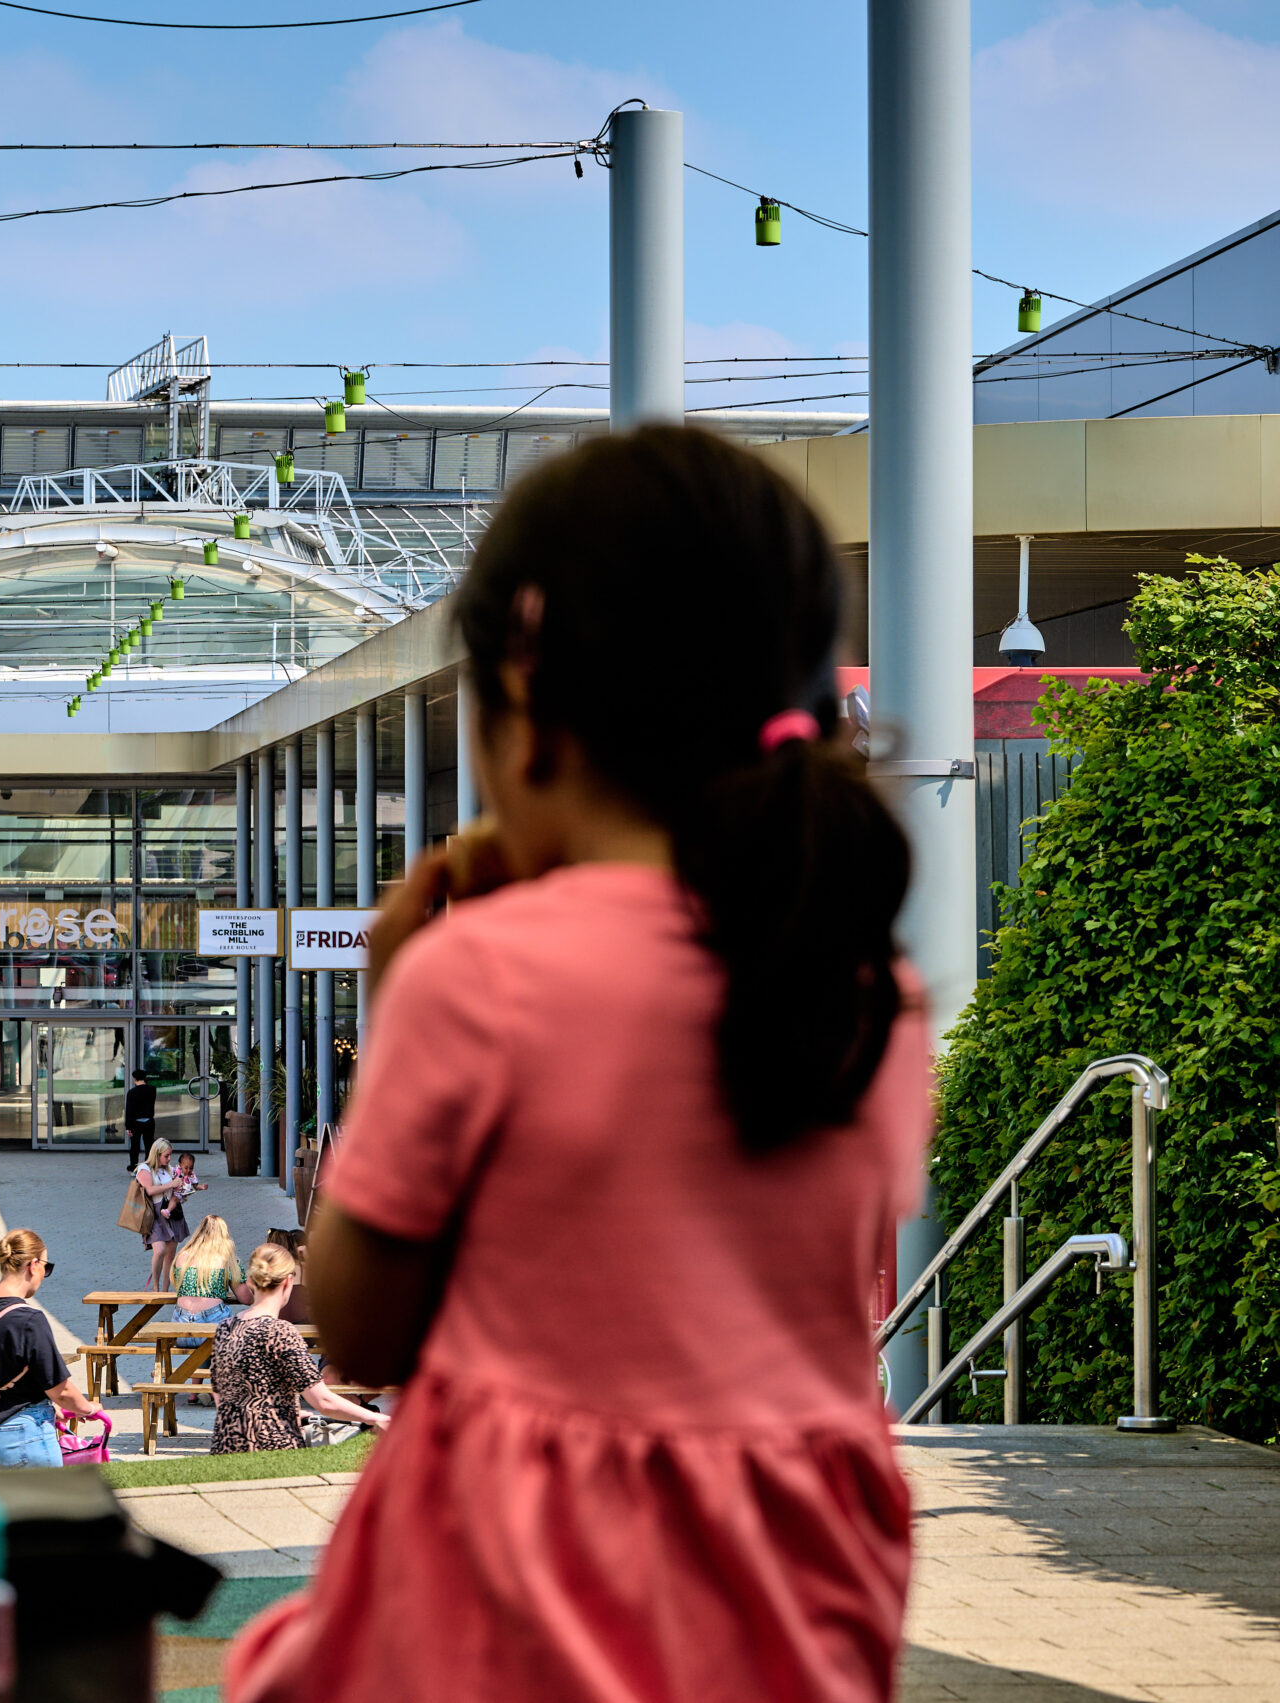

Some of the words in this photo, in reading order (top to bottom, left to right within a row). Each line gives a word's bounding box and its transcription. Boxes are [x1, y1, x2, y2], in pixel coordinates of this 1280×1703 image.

[0, 907, 117, 943] rose
[212, 929, 265, 937] SCRIBBLING
[296, 930, 305, 948] TGI
